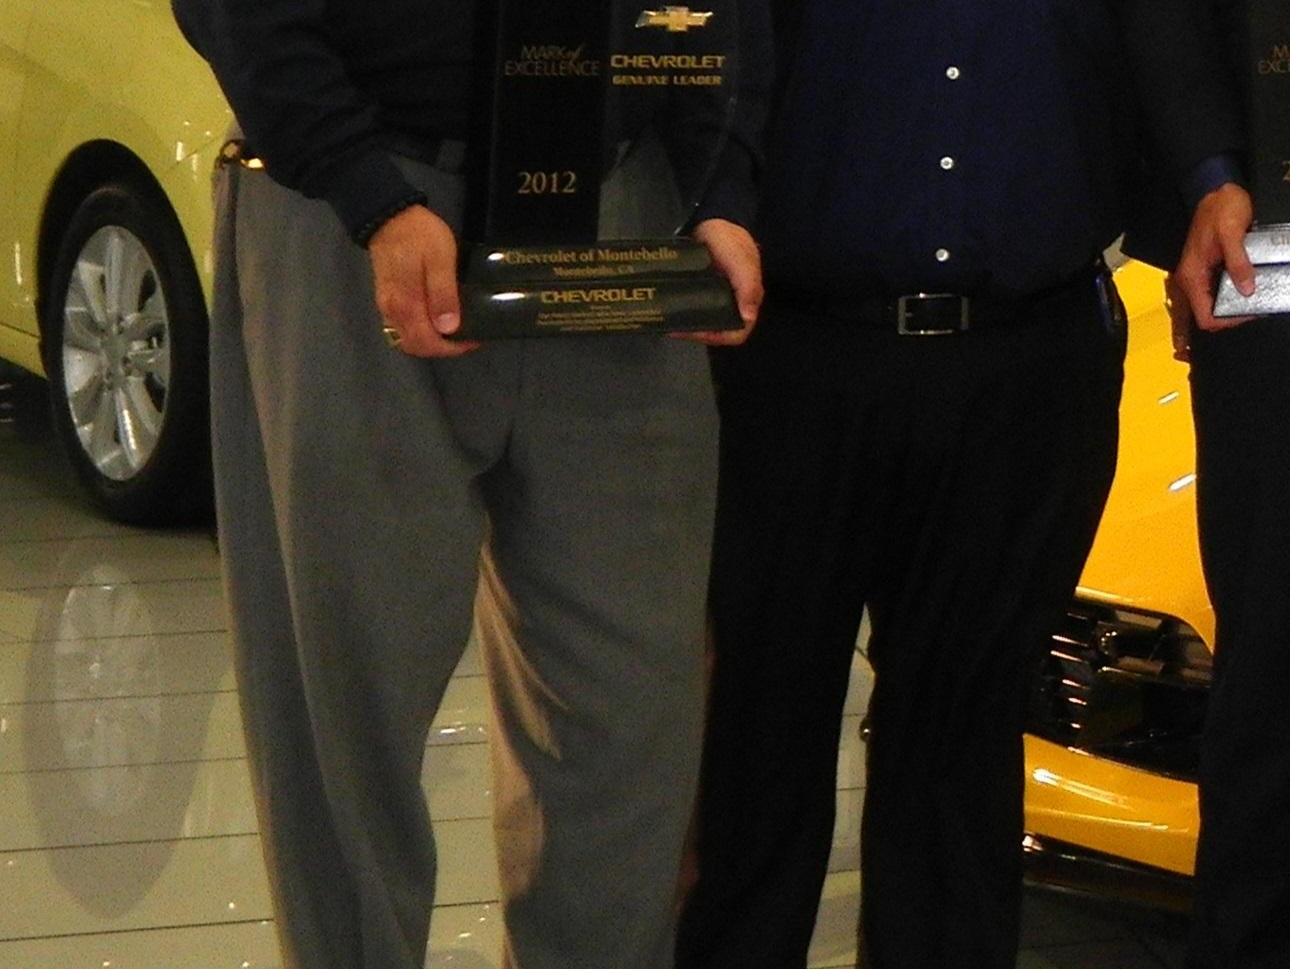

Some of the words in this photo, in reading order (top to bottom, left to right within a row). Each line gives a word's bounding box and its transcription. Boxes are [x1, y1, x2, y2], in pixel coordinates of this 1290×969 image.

[504, 59, 601, 77] EXCELLENCE
[610, 54, 727, 68] CHEVROLET
[612, 74, 669, 85] GENUINE
[673, 74, 723, 86] LEADER
[517, 170, 577, 195] 2012
[504, 249, 576, 264] Chevrolet
[579, 249, 595, 262] of
[598, 246, 679, 263] Montebello
[541, 287, 656, 303] CHEVROLET
